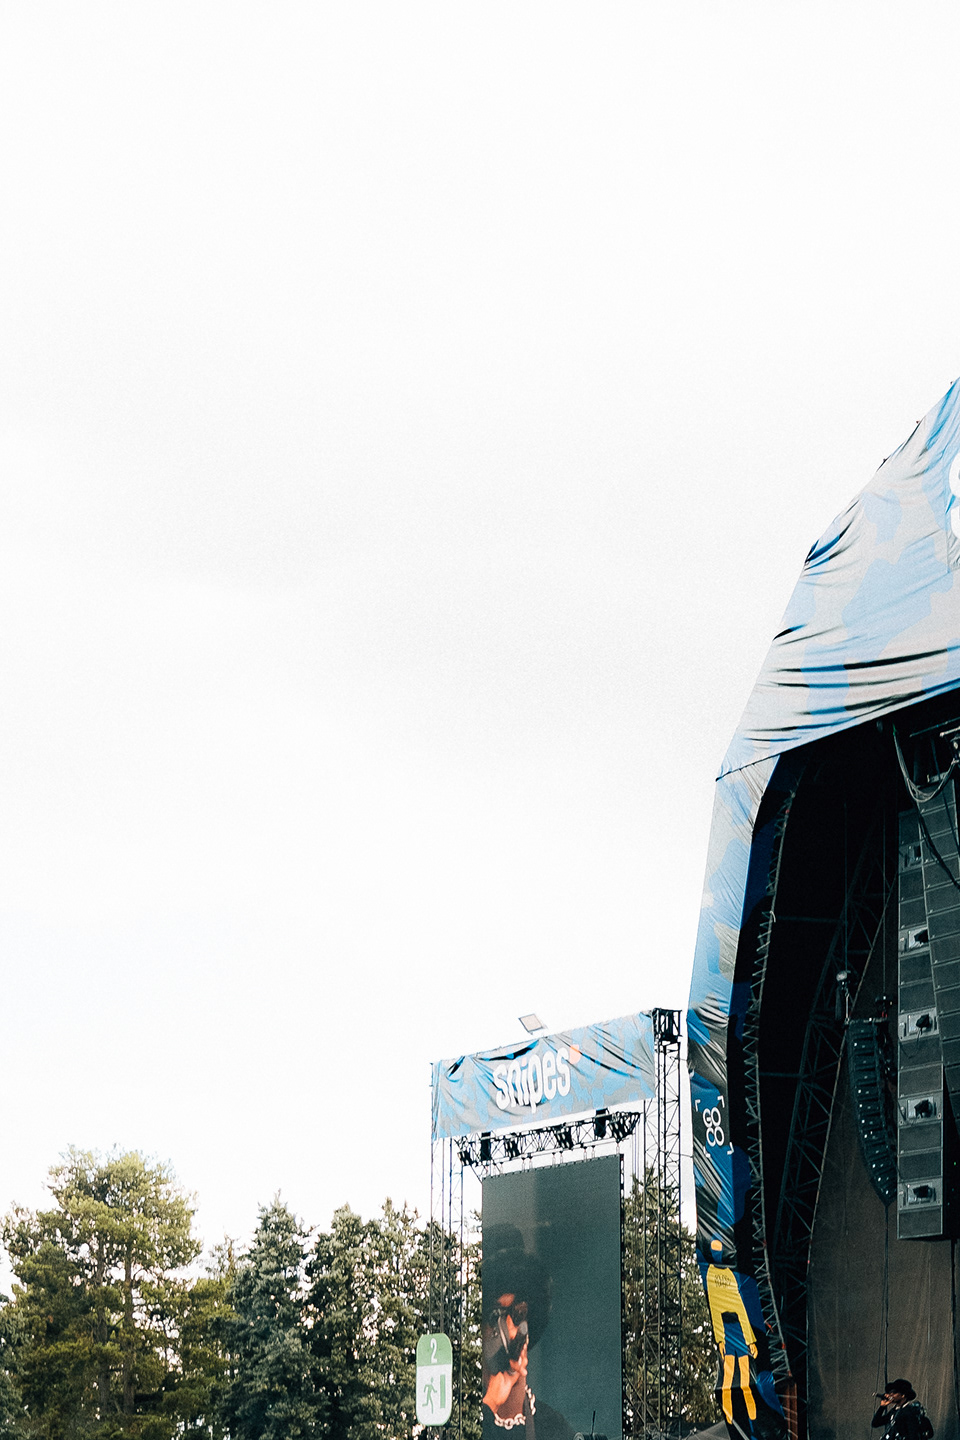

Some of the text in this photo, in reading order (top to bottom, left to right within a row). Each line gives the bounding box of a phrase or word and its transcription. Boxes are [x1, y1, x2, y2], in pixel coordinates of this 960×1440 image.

[493, 1047, 571, 1114] snipes
[702, 1107, 721, 1128] GO
[706, 1126, 724, 1147] CO
[430, 1337, 438, 1364] 2
